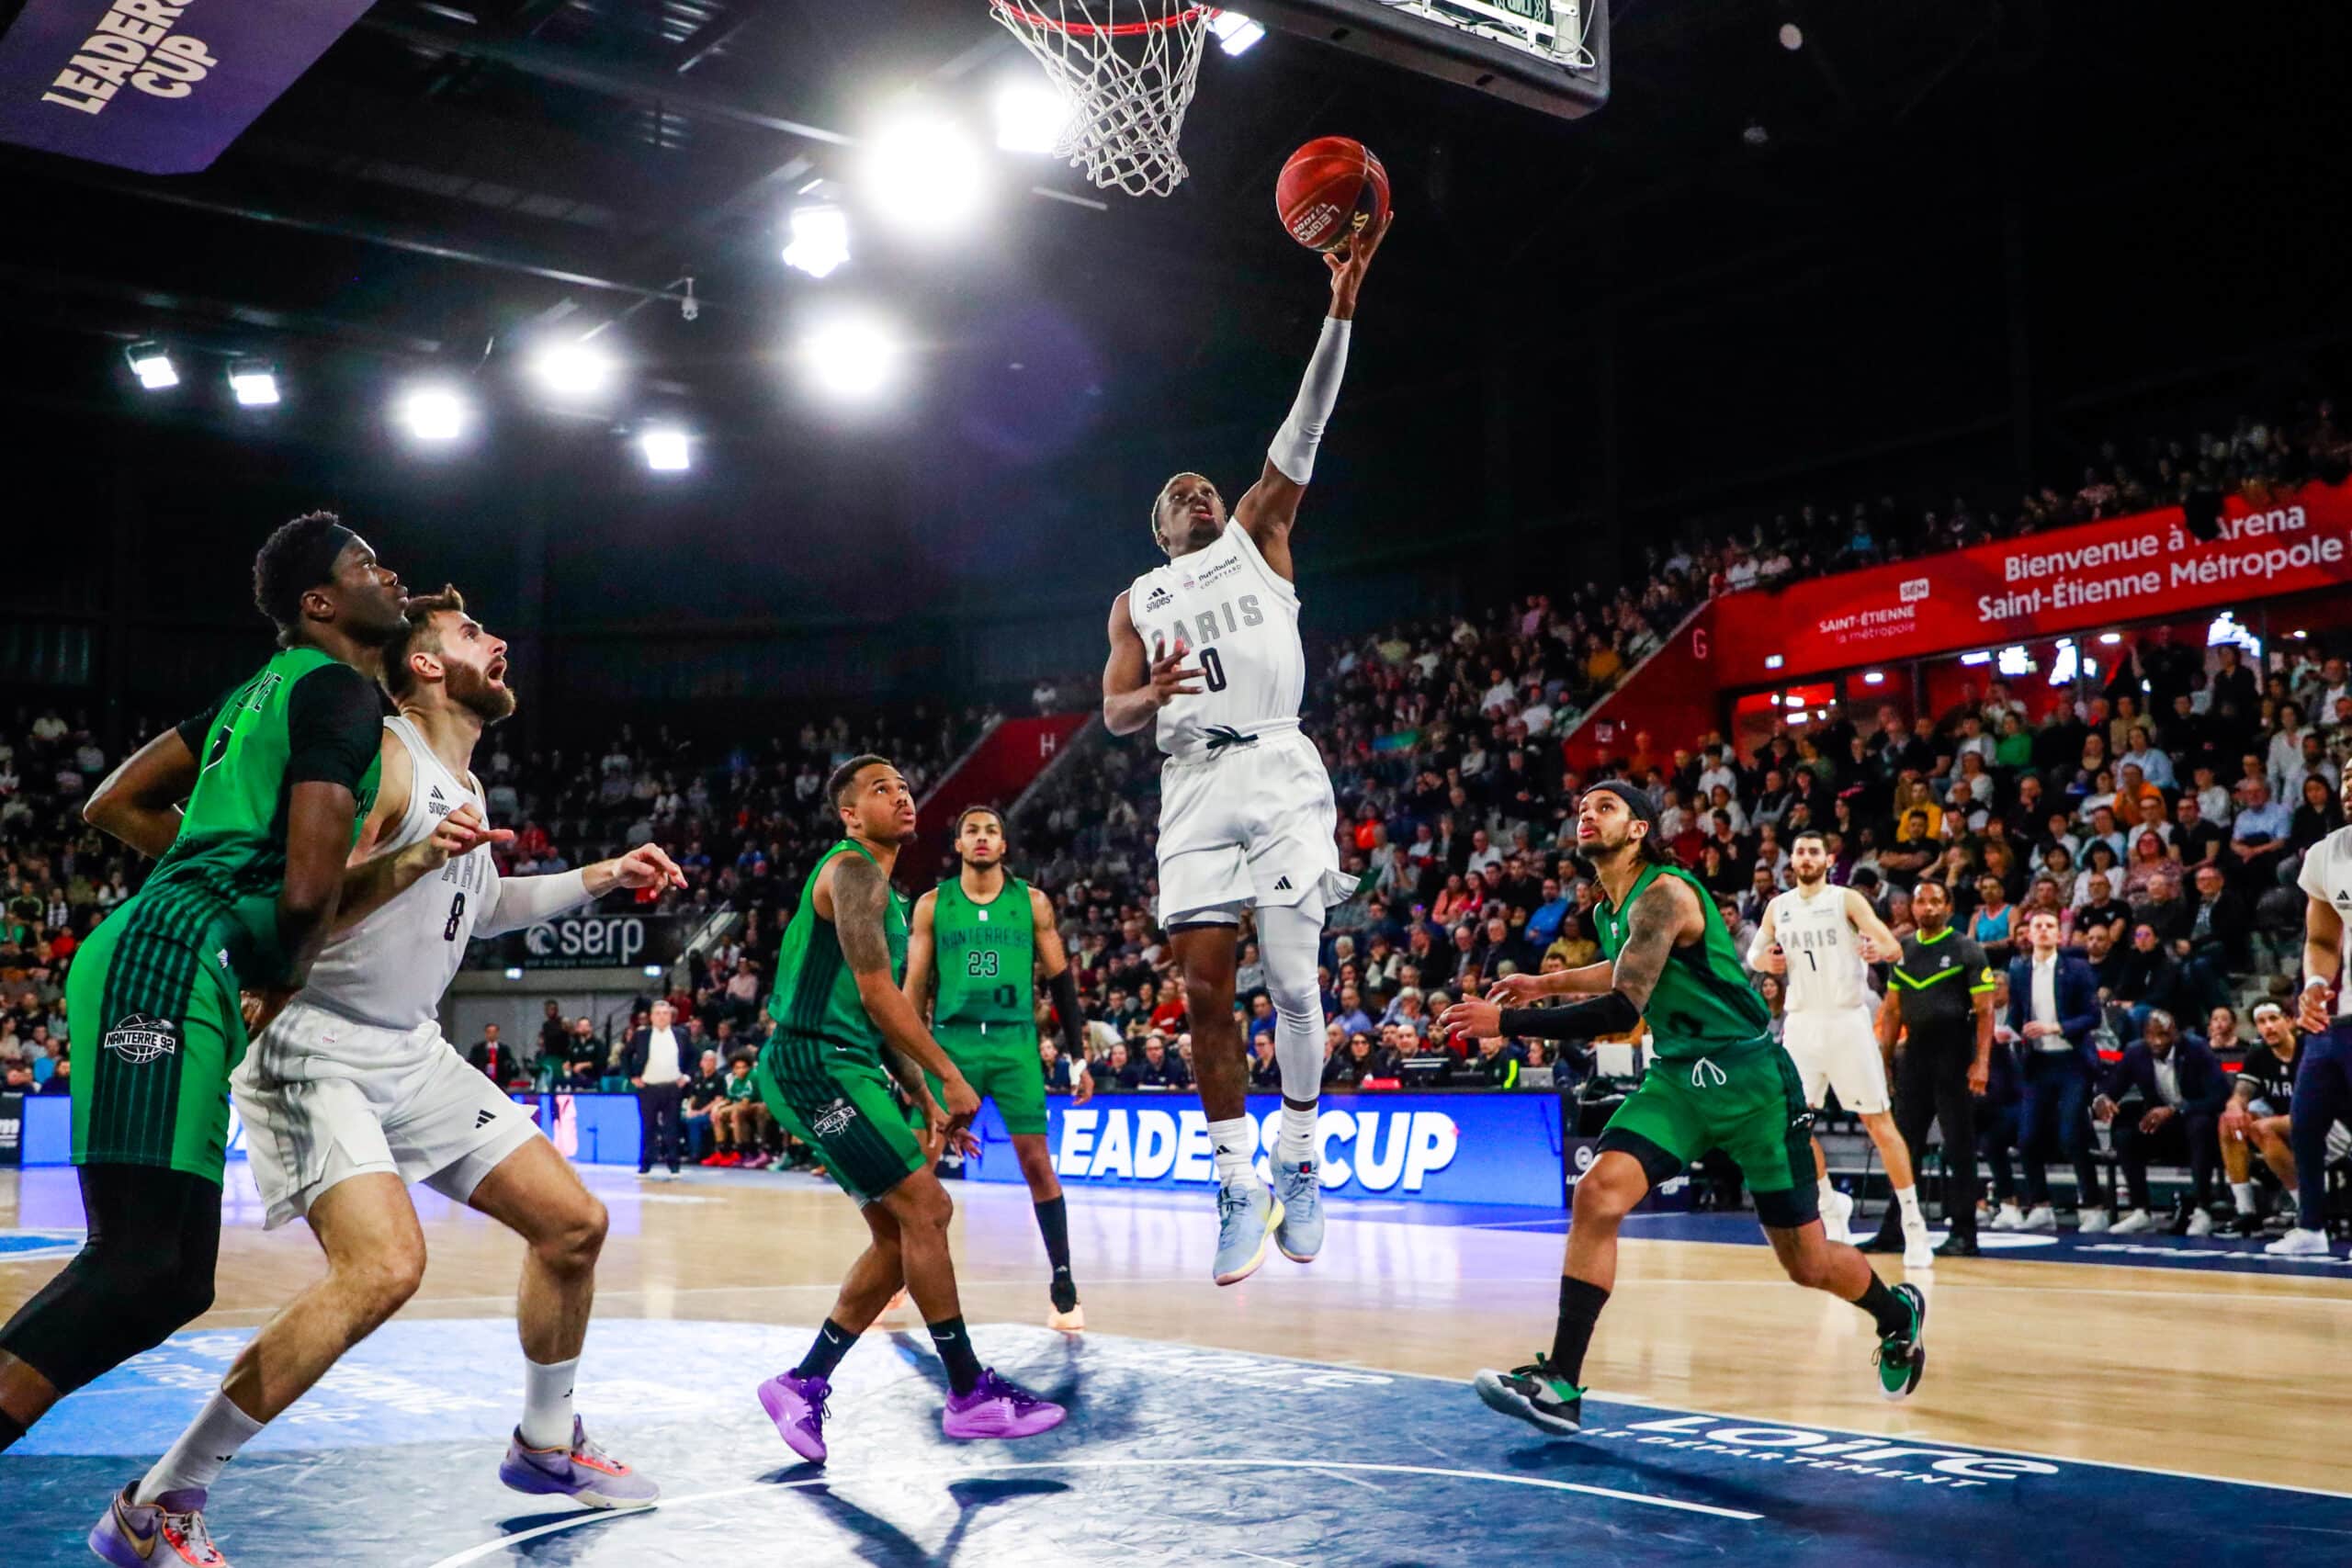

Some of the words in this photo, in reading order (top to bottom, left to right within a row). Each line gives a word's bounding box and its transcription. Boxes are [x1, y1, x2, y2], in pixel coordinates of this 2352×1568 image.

[130, 35, 219, 98] CUP
[2005, 534, 2159, 582] Bienvenue
[2166, 523, 2185, 552] à
[2194, 505, 2307, 547] Arena
[1978, 570, 2161, 623] Saint-Étienne
[2170, 534, 2344, 589] Métropole
[1819, 604, 1916, 634] SAINT-ÉTIENNE
[1692, 628, 1708, 660] G
[1199, 647, 1227, 694] 0
[1040, 733, 1056, 758] H
[443, 892, 466, 942] 8
[560, 919, 644, 964] serp
[967, 950, 1000, 978] 23
[106, 1032, 158, 1046] NANTERRE
[160, 1036, 175, 1052] 92
[1316, 1109, 1457, 1191] CUP
[1626, 1416, 2059, 1480] Loire
